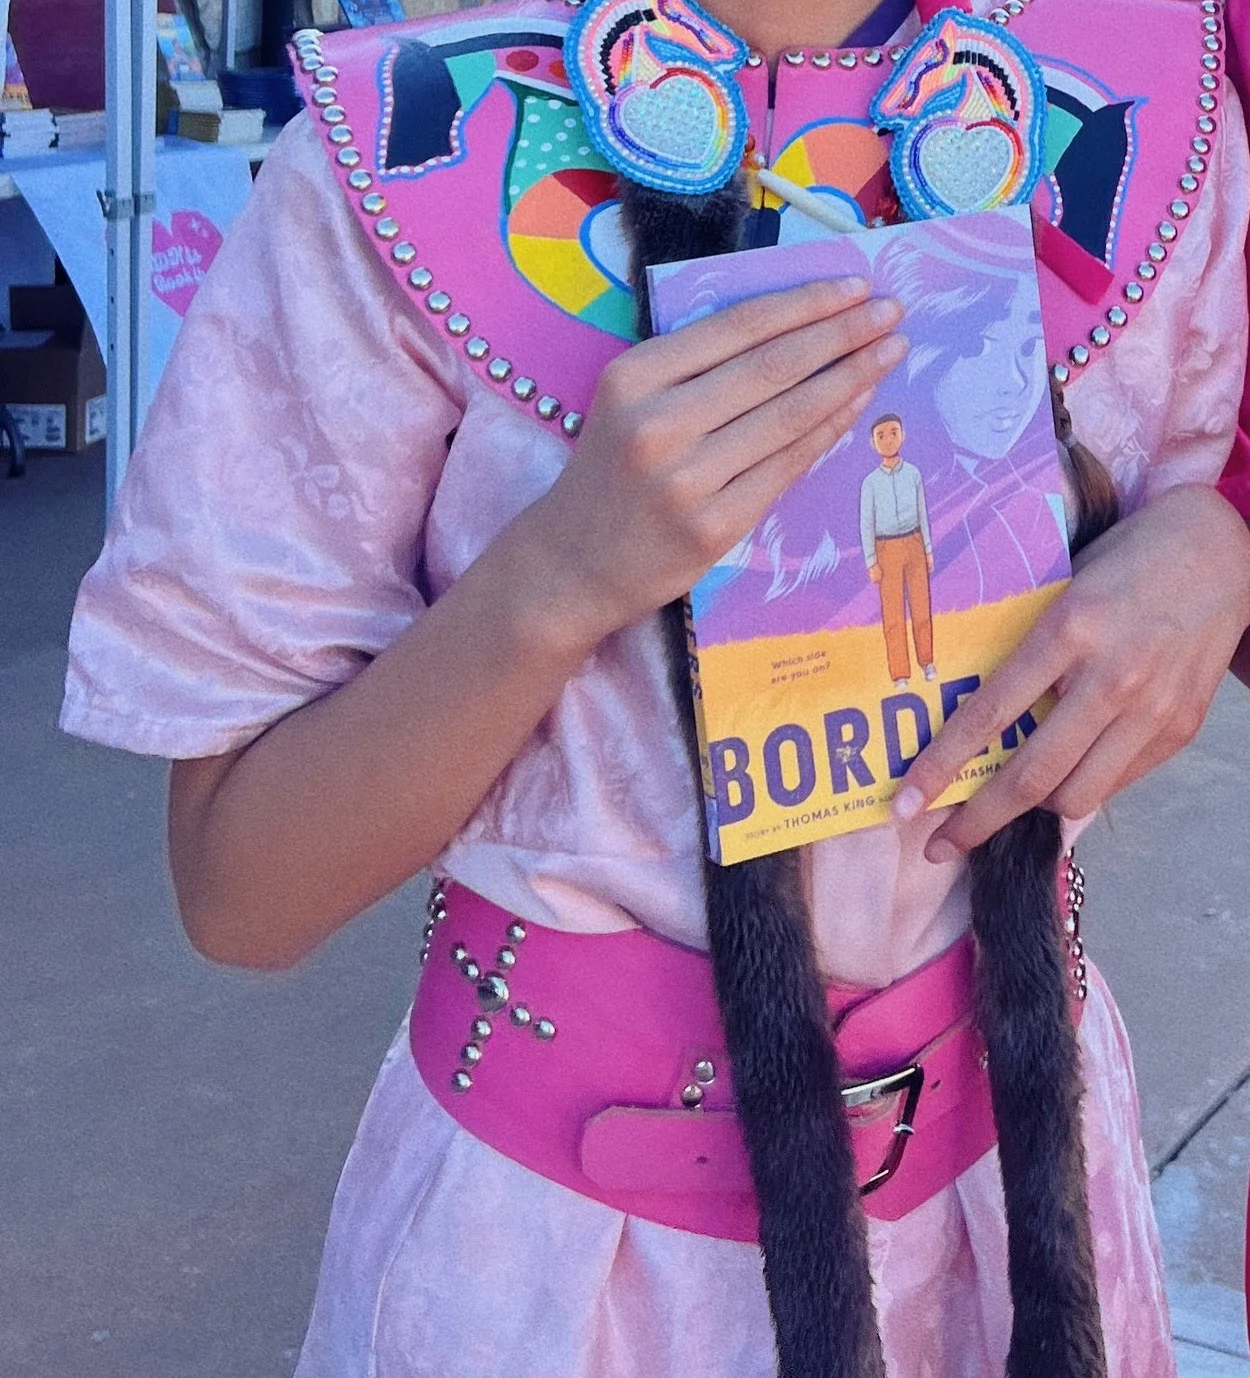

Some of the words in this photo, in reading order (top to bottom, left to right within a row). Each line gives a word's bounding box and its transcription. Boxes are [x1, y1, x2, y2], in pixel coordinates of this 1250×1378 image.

[771, 656, 804, 670] Which
[806, 650, 827, 662] side
[771, 674, 787, 684] are
[791, 669, 810, 682] you
[812, 661, 831, 674] on?
[784, 805, 839, 830] THOMAS
[843, 795, 876, 813] KING
